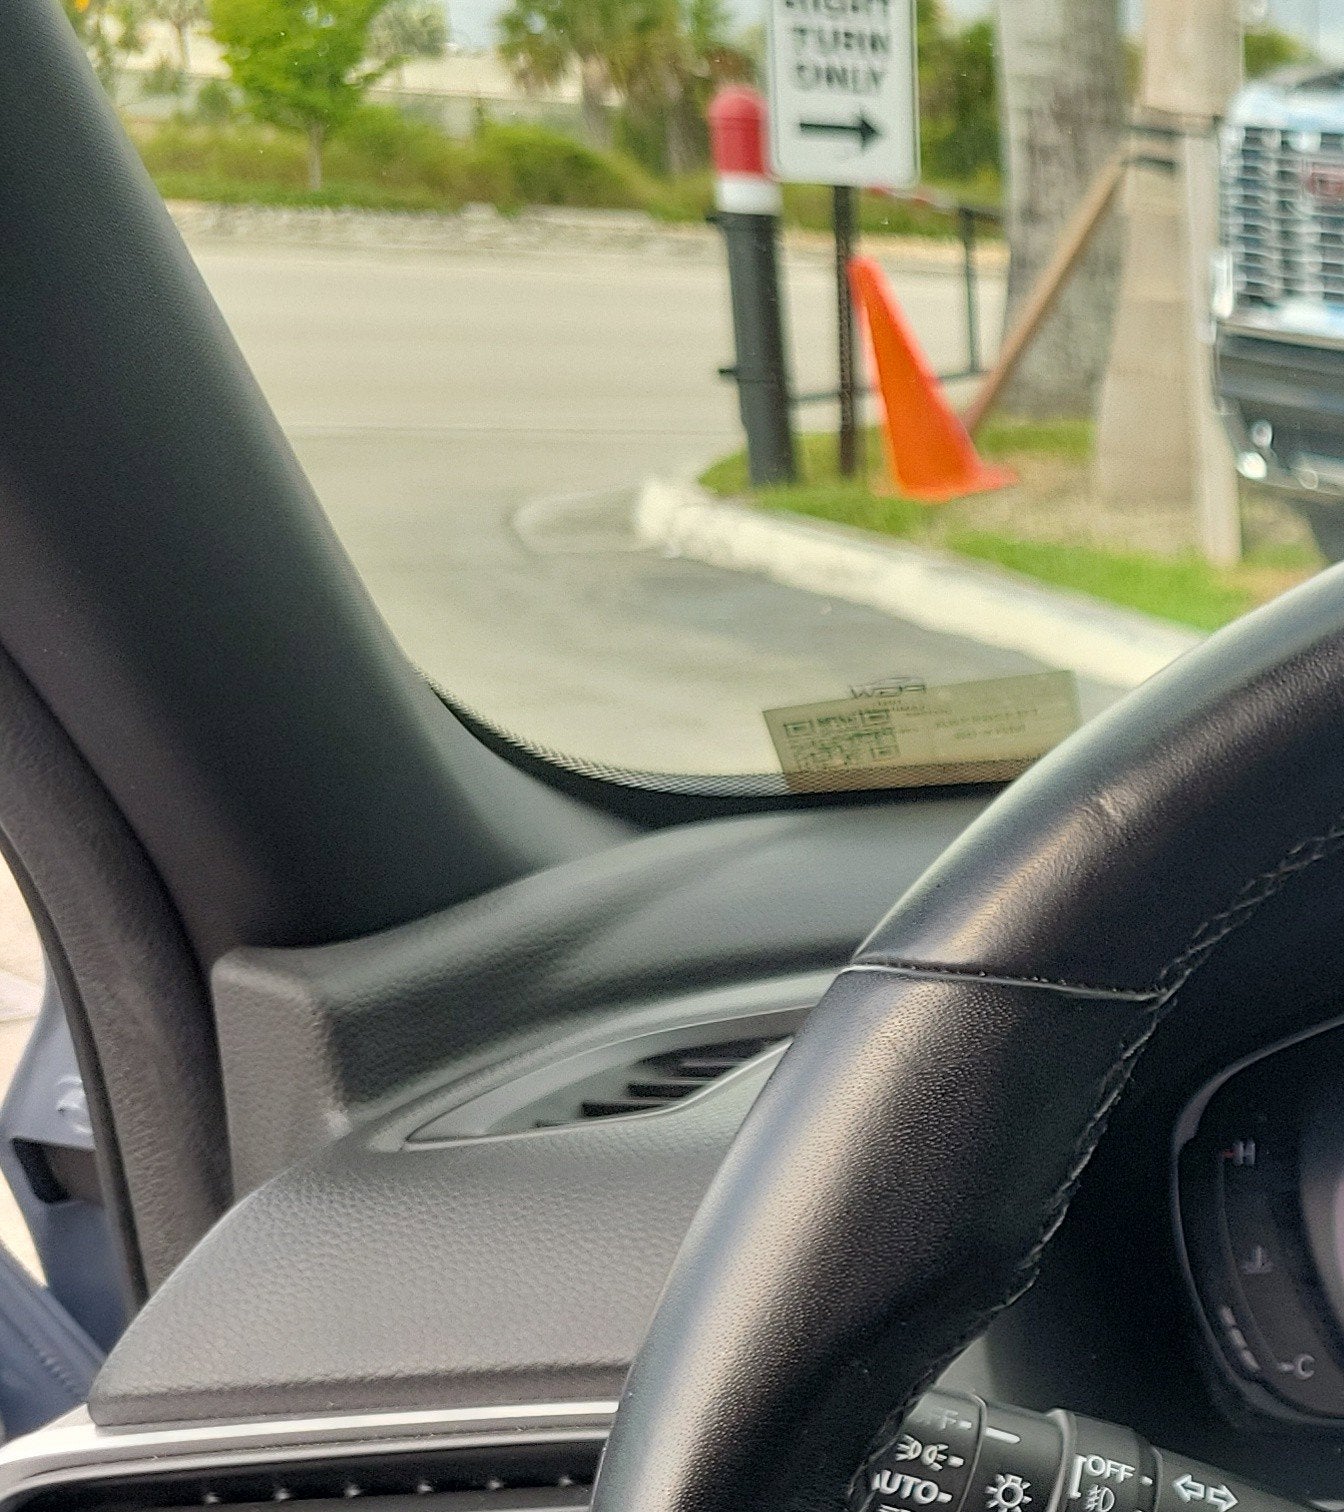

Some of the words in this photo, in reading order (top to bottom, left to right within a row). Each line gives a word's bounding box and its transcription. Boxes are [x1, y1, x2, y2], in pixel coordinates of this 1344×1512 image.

[793, 25, 890, 53] TURN
[794, 62, 886, 92] ONLY
[1085, 1454, 1136, 1485] OFF
